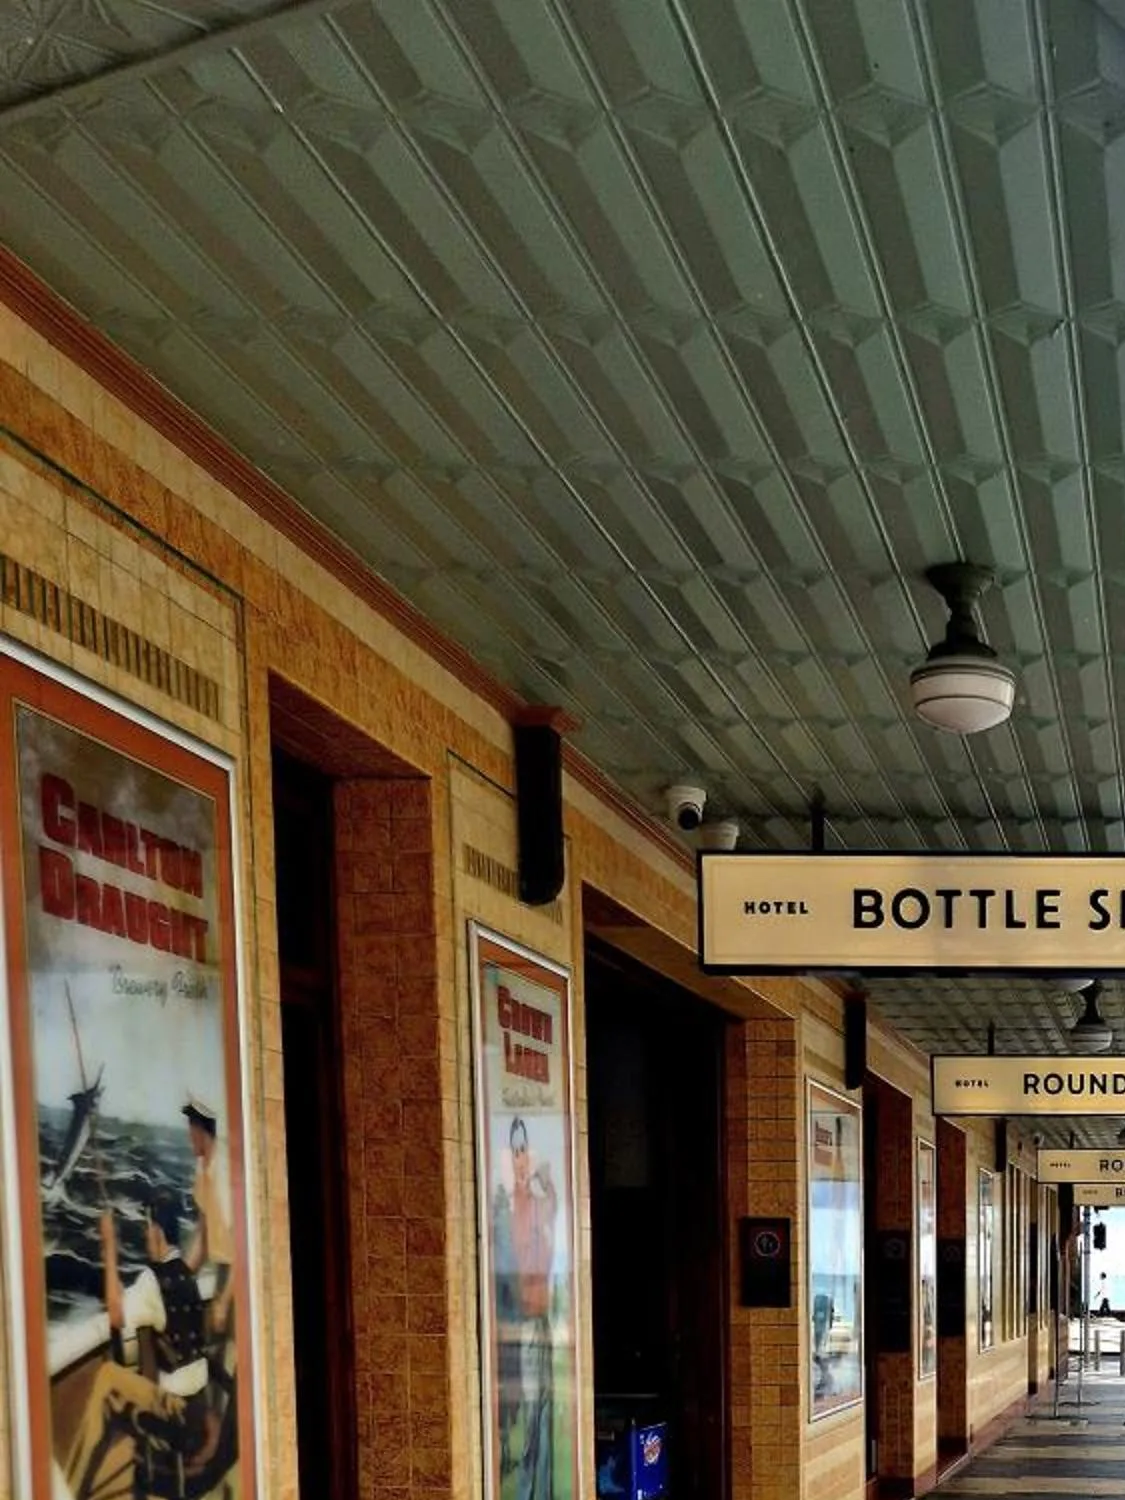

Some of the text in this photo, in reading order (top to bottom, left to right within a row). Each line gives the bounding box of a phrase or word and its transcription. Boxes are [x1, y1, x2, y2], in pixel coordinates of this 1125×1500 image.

[38, 845, 209, 963] DRAUGHT
[744, 901, 809, 915] HOTEL
[852, 887, 1062, 930] BOTTLE
